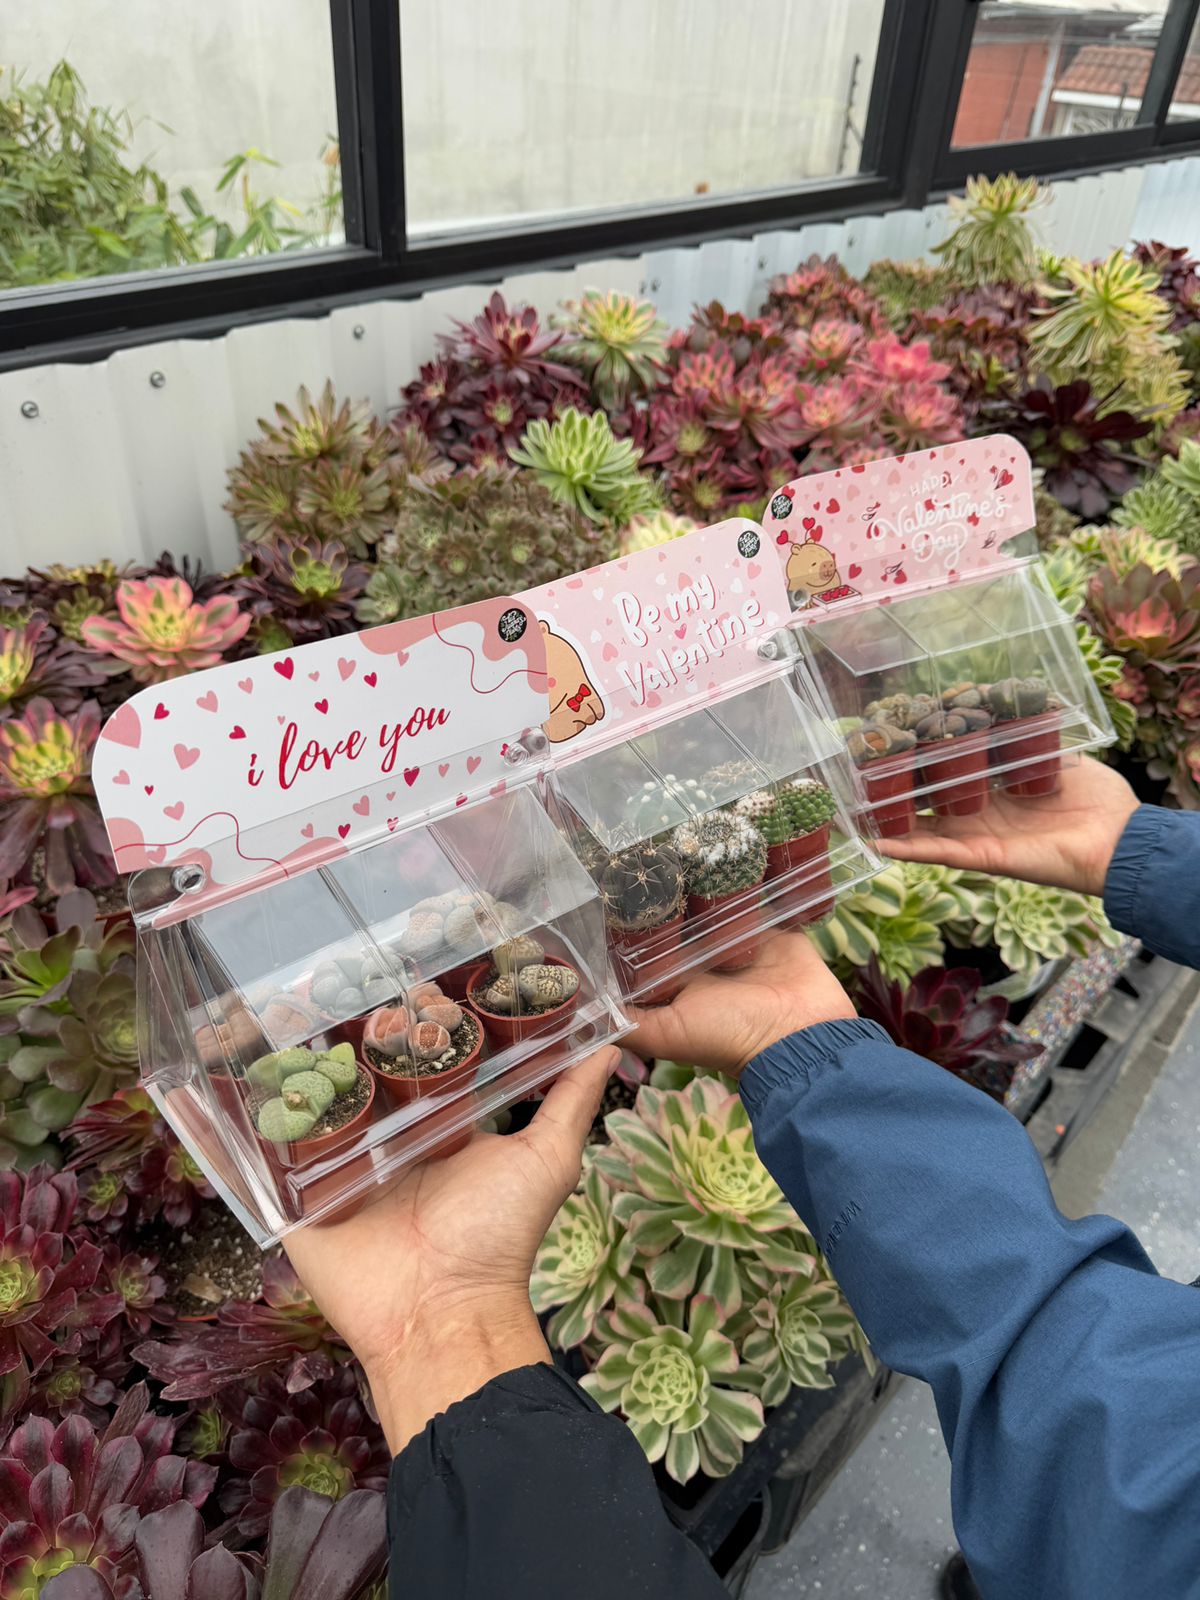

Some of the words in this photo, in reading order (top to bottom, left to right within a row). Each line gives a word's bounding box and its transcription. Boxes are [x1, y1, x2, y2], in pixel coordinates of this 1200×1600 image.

[870, 492, 1012, 540] Valentine's
[911, 522, 968, 569] Day
[612, 592, 662, 647] Be
[665, 574, 716, 621] my
[616, 599, 765, 705] Valentine
[247, 753, 264, 786] i
[278, 722, 367, 790] love
[379, 706, 451, 773] you
